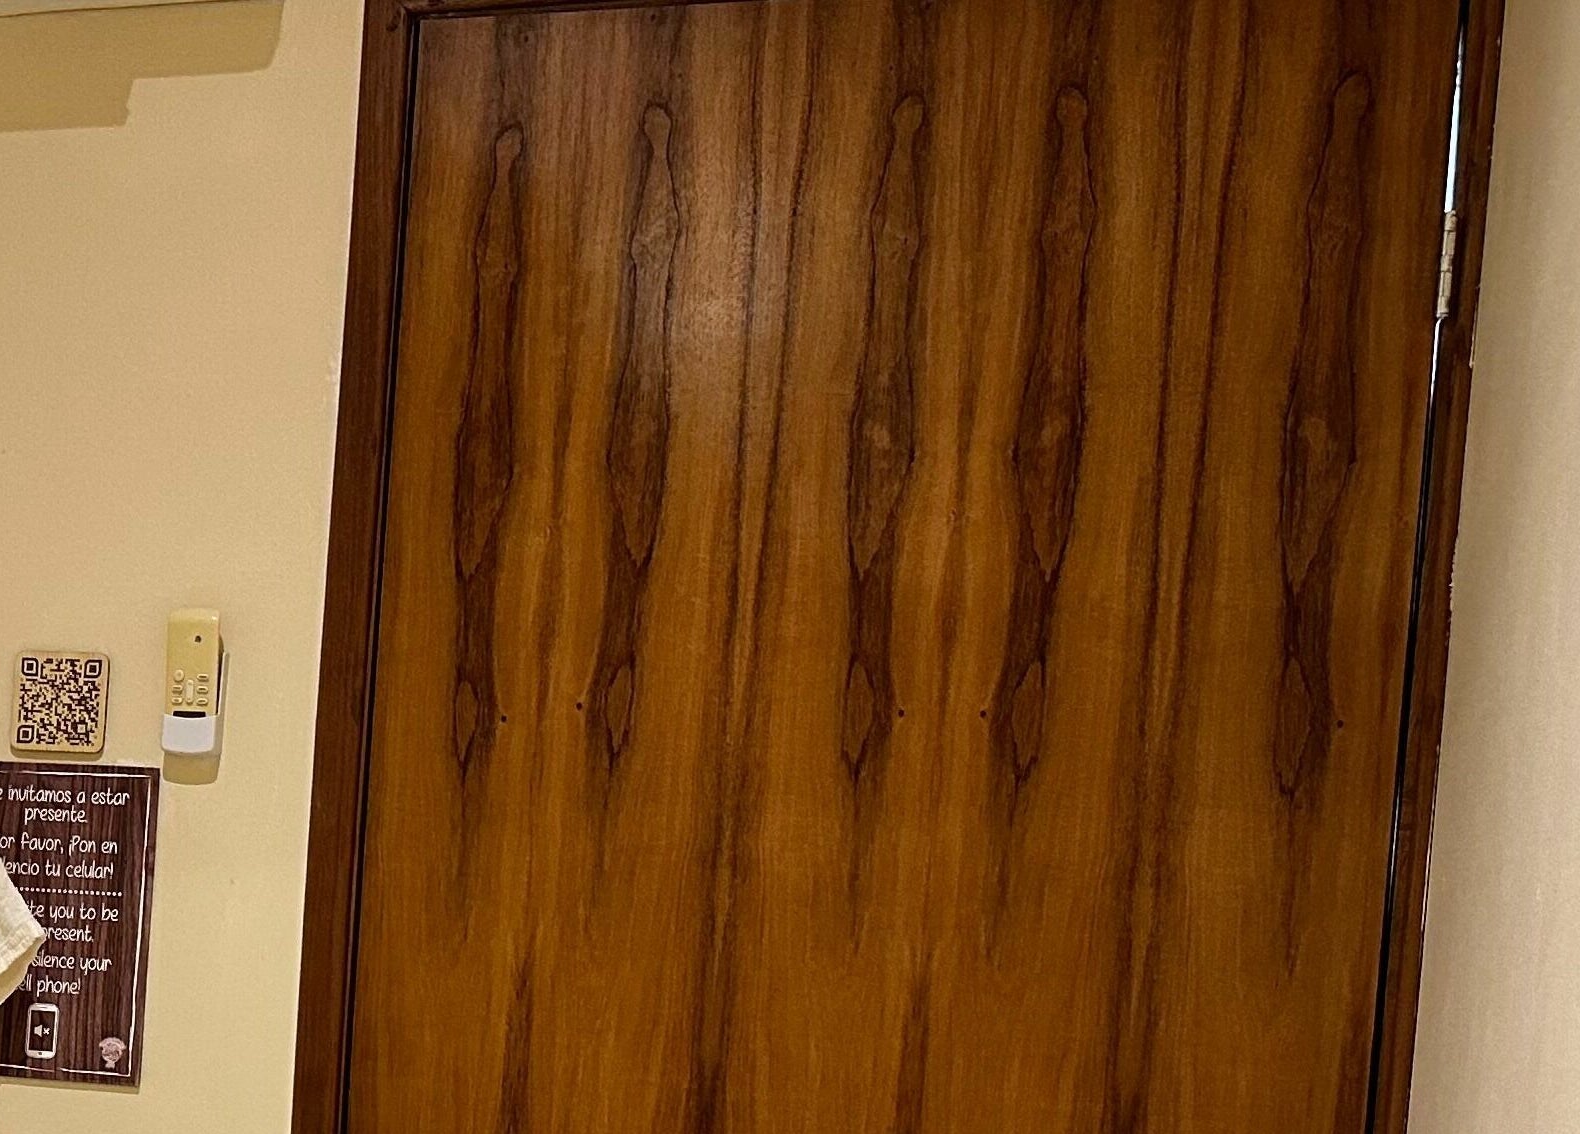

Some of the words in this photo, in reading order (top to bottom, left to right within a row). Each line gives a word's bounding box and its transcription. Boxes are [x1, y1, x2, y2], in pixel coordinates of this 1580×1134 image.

[8, 784, 72, 804] invitamos
[76, 791, 86, 804] a
[91, 788, 130, 806] estar
[20, 831, 64, 855] favor,
[101, 841, 118, 854] en
[45, 859, 61, 877] tu
[65, 859, 114, 880] celular!
[49, 905, 74, 923] you
[80, 902, 96, 920] to
[101, 903, 118, 922] be
[80, 957, 112, 976] your
[36, 975, 81, 998] phone!
